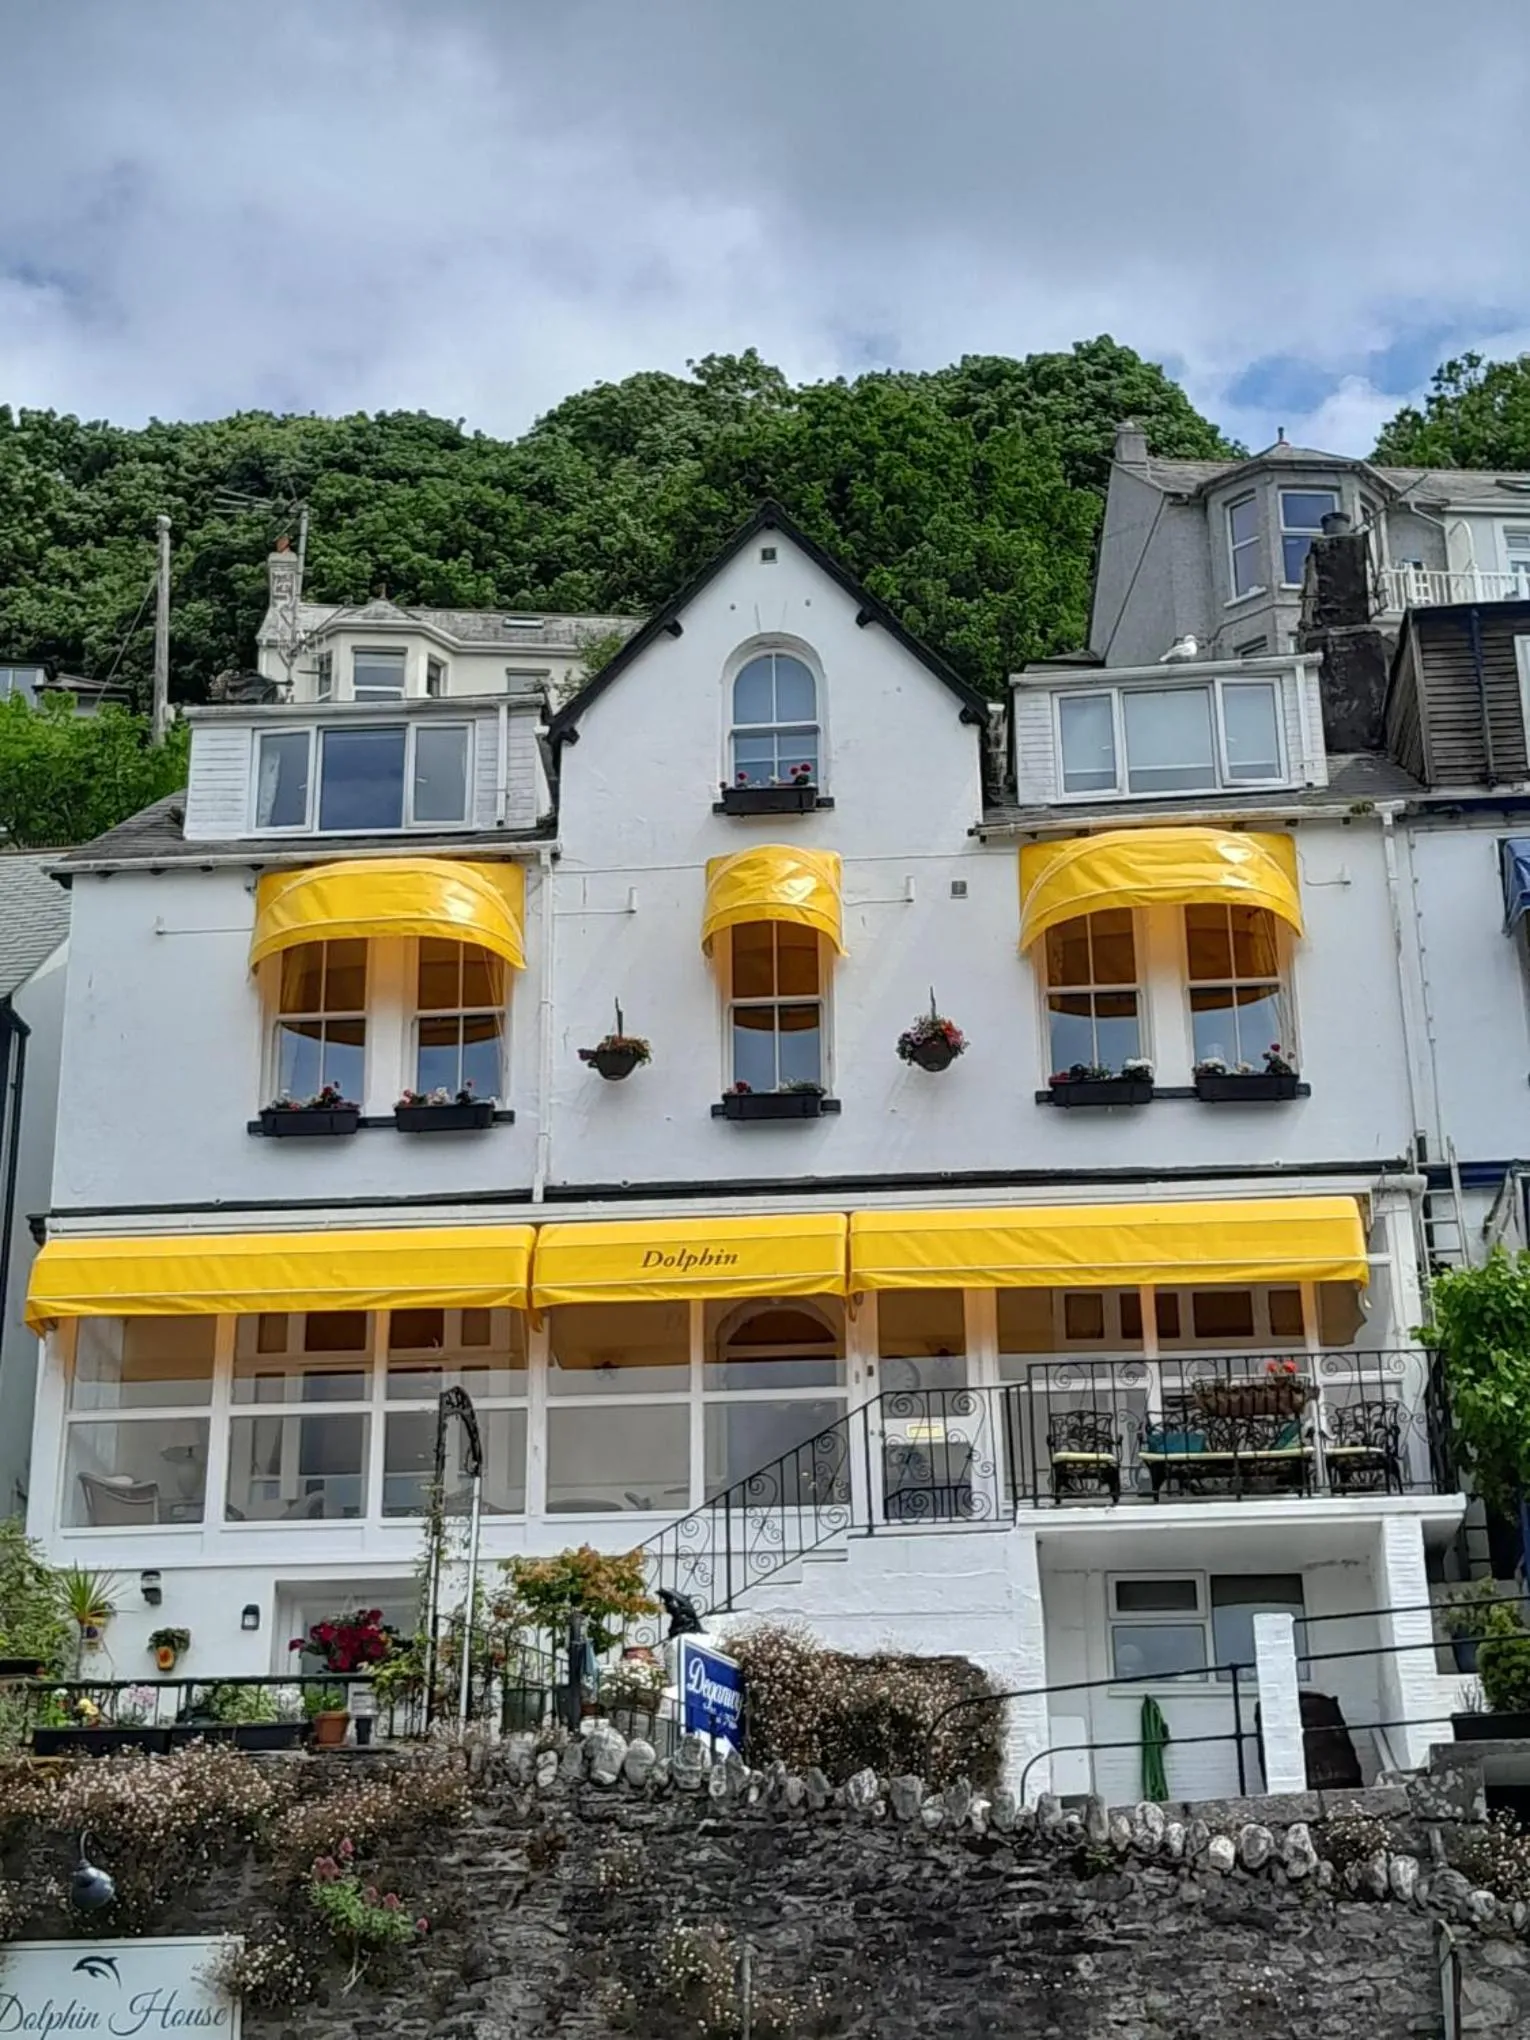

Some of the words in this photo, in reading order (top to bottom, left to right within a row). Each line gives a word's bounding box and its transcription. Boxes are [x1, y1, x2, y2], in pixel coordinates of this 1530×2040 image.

[641, 1247, 739, 1273] Dolphin
[0, 1992, 101, 2040] Dolphin
[108, 1988, 228, 2036] House
